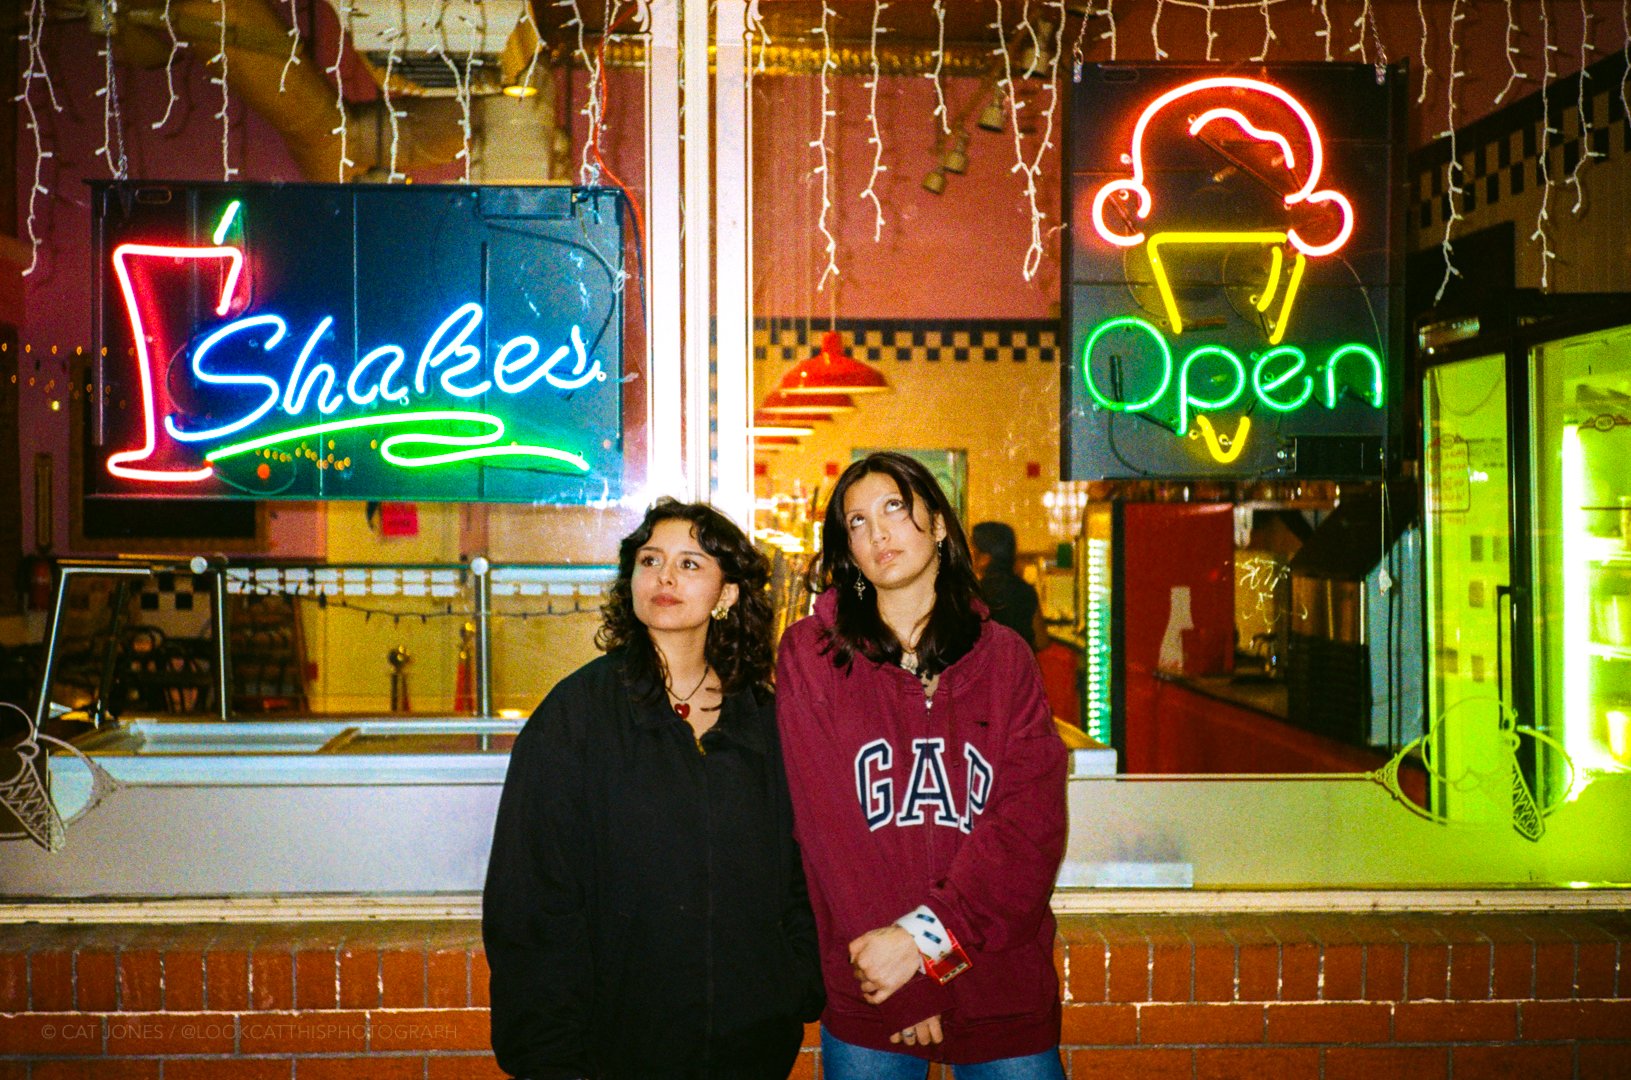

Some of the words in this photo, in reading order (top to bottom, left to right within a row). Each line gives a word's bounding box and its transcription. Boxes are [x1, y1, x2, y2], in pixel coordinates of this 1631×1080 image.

[164, 301, 605, 442] Shakes
[1082, 316, 1384, 437] Open
[854, 737, 994, 835] GAP
